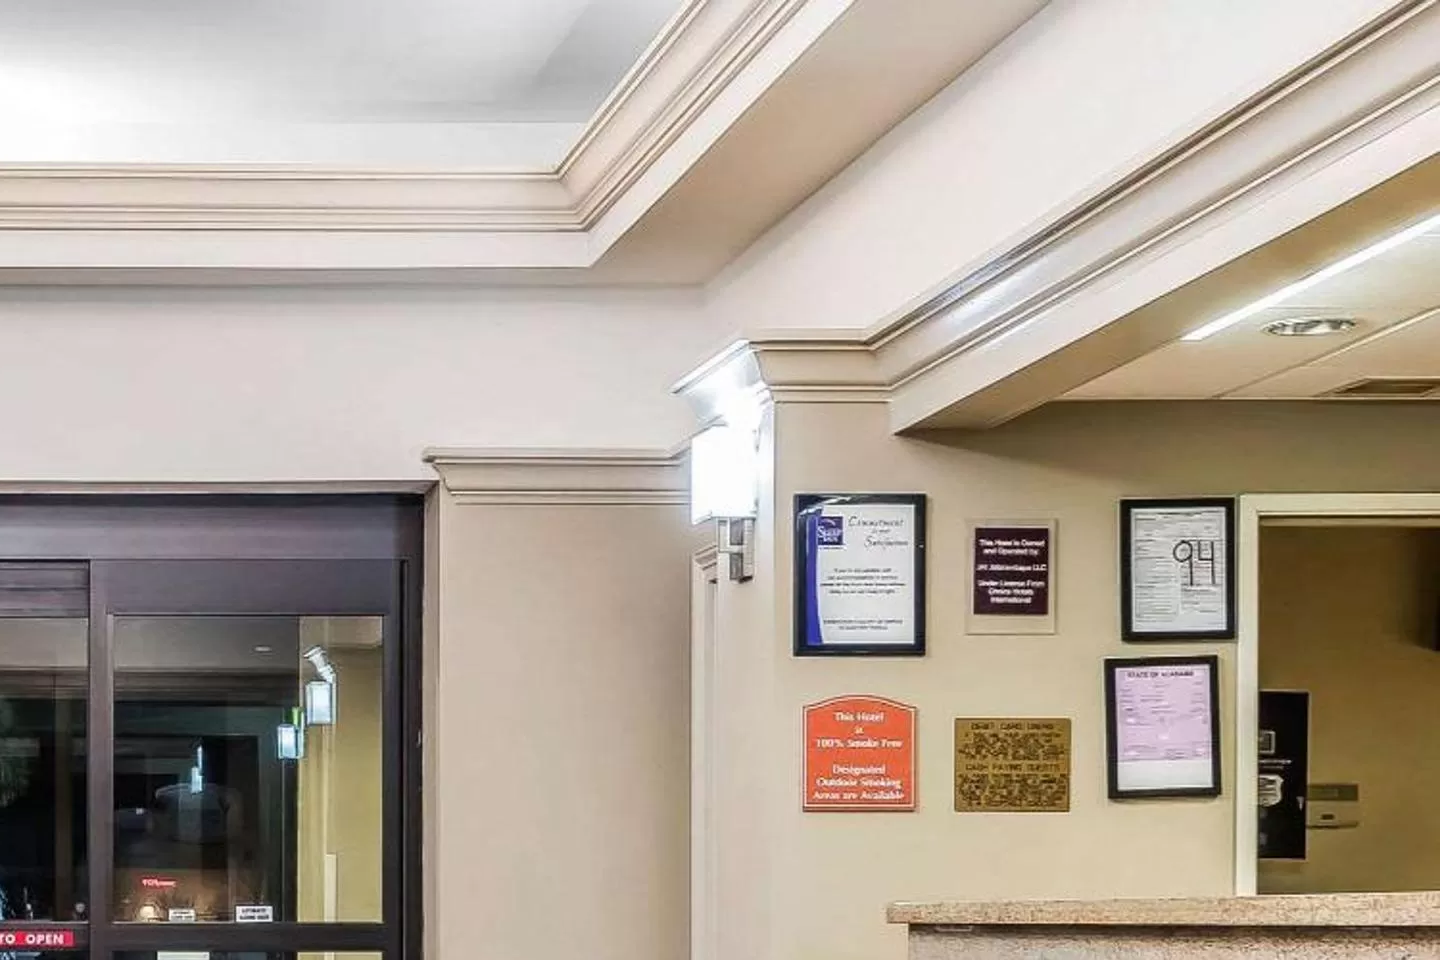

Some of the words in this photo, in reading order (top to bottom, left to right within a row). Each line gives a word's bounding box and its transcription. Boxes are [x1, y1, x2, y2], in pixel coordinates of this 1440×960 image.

[1173, 540, 1216, 586] 94
[834, 711, 855, 721] This
[857, 711, 885, 722] Hotel
[816, 738, 845, 748] 100%
[846, 738, 879, 748] Smoke
[881, 738, 903, 748] Free
[832, 763, 887, 777] Designated
[816, 777, 858, 788] Outdoor
[860, 777, 903, 790] Smoking
[813, 790, 841, 800] Areas
[843, 791, 858, 800] are
[860, 789, 905, 800] Available
[25, 932, 64, 945] OPEN
